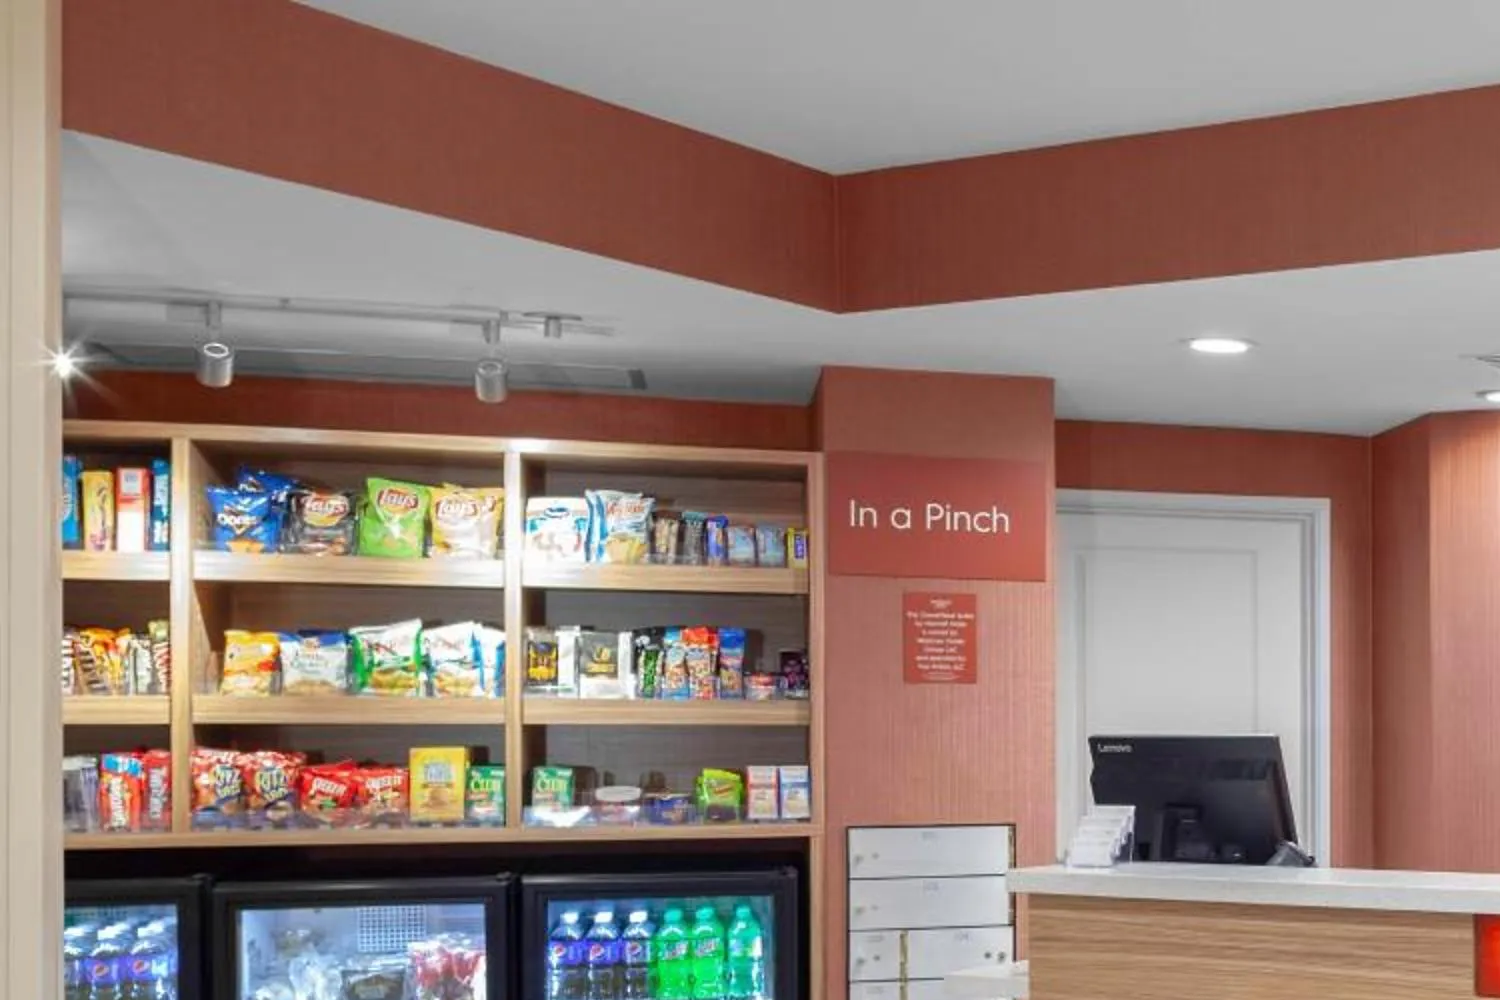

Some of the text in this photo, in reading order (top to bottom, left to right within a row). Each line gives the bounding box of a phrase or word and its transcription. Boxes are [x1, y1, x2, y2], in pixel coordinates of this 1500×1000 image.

[850, 500, 1009, 533] In a Pinch
[1097, 743, 1132, 753] Lenovo
